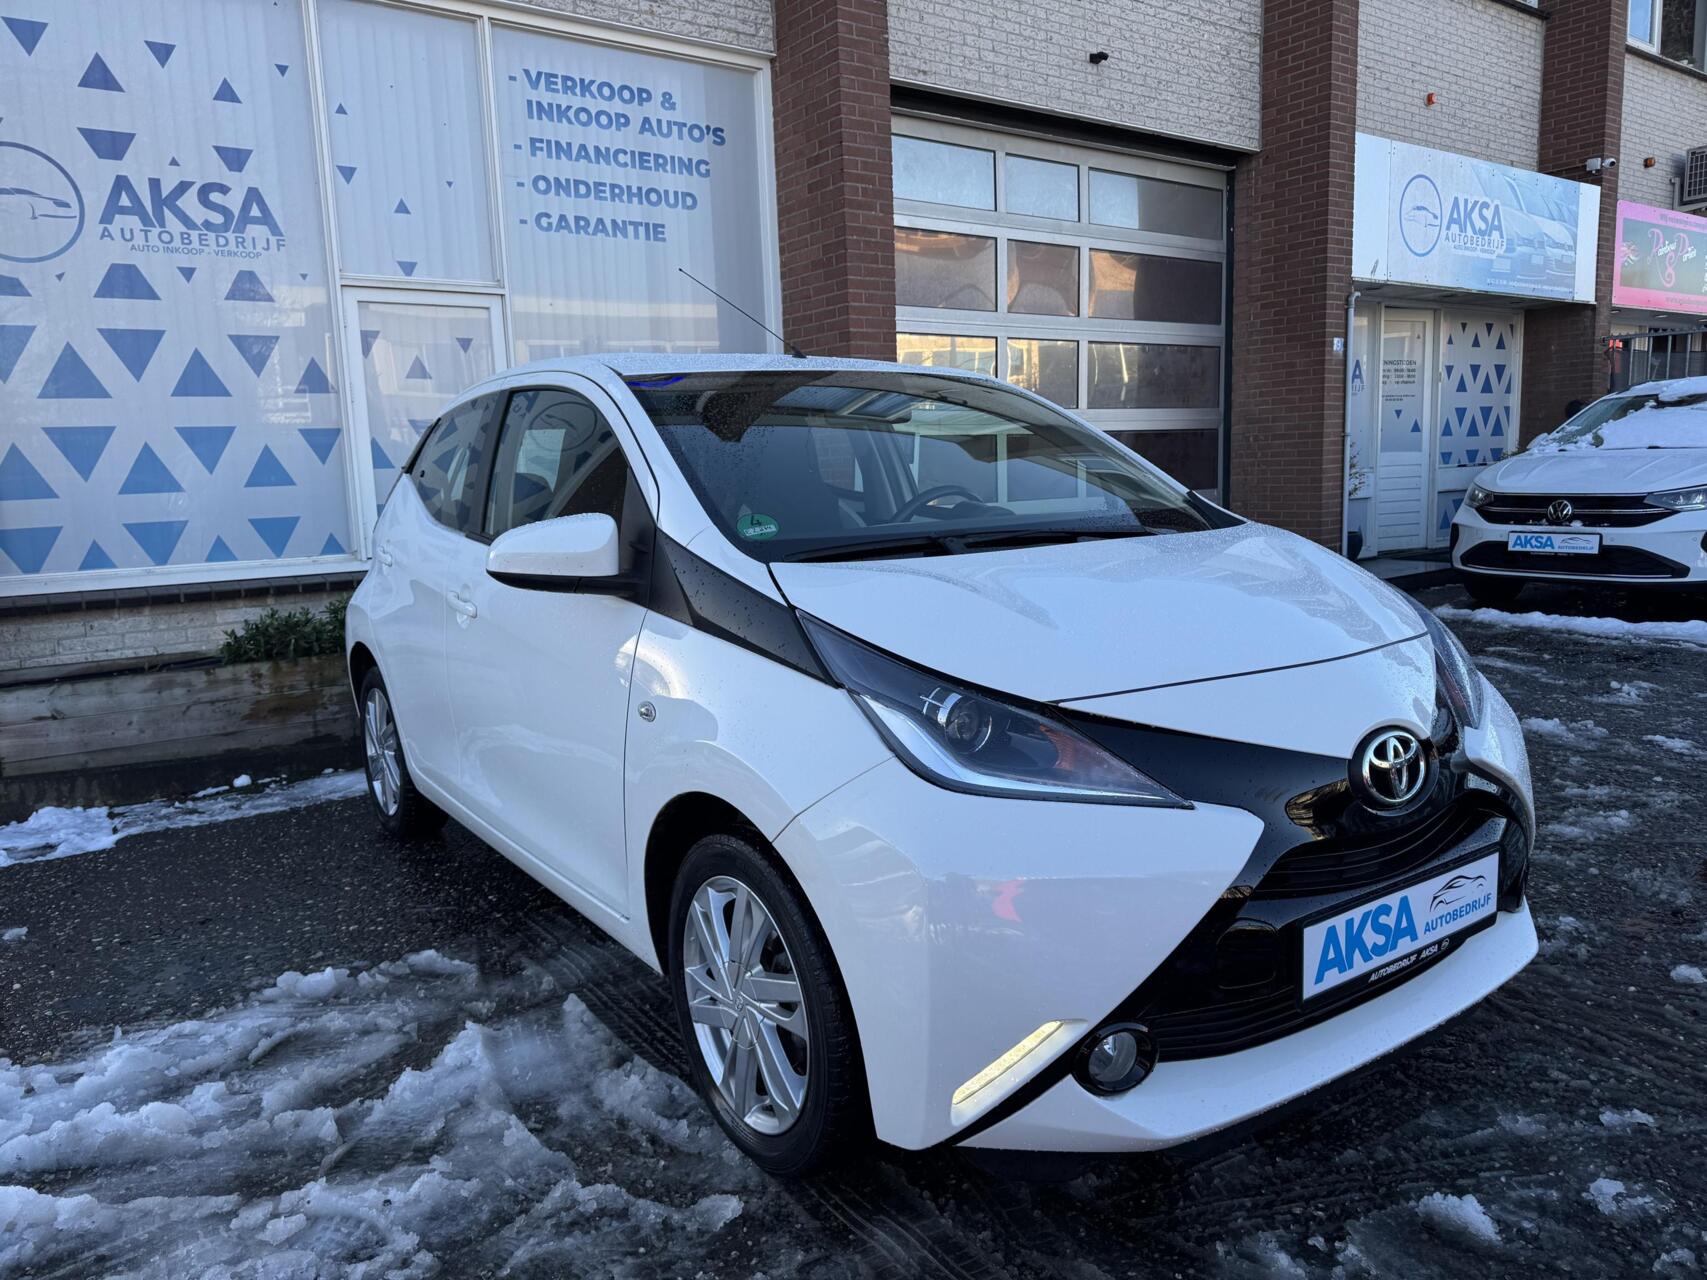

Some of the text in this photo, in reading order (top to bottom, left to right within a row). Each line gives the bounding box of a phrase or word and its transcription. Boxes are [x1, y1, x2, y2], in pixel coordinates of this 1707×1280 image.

[522, 68, 653, 107] VERKOOP
[661, 91, 677, 111] &
[526, 99, 726, 146] INKOOP AUTO'S
[529, 136, 711, 178] FINANCIERING
[98, 174, 285, 237] AKSA
[531, 174, 698, 211] ONDERHOUD
[534, 212, 667, 242] GARANTIE
[1445, 196, 1504, 239] AKSA
[99, 226, 286, 251] AUTOBEDRIJF
[130, 244, 160, 253] AUTO
[162, 246, 205, 256] INKOOP
[213, 249, 262, 259] VERKOOP
[1444, 232, 1505, 250] AUTOBEDRIJF
[751, 515, 761, 526] 4
[1512, 535, 1555, 549] AKSA
[1423, 892, 1492, 935] AUTOBEDRIJF
[1314, 895, 1419, 985] AKSA
[1368, 945, 1438, 983] AUTOBEDRIJF AKSA
